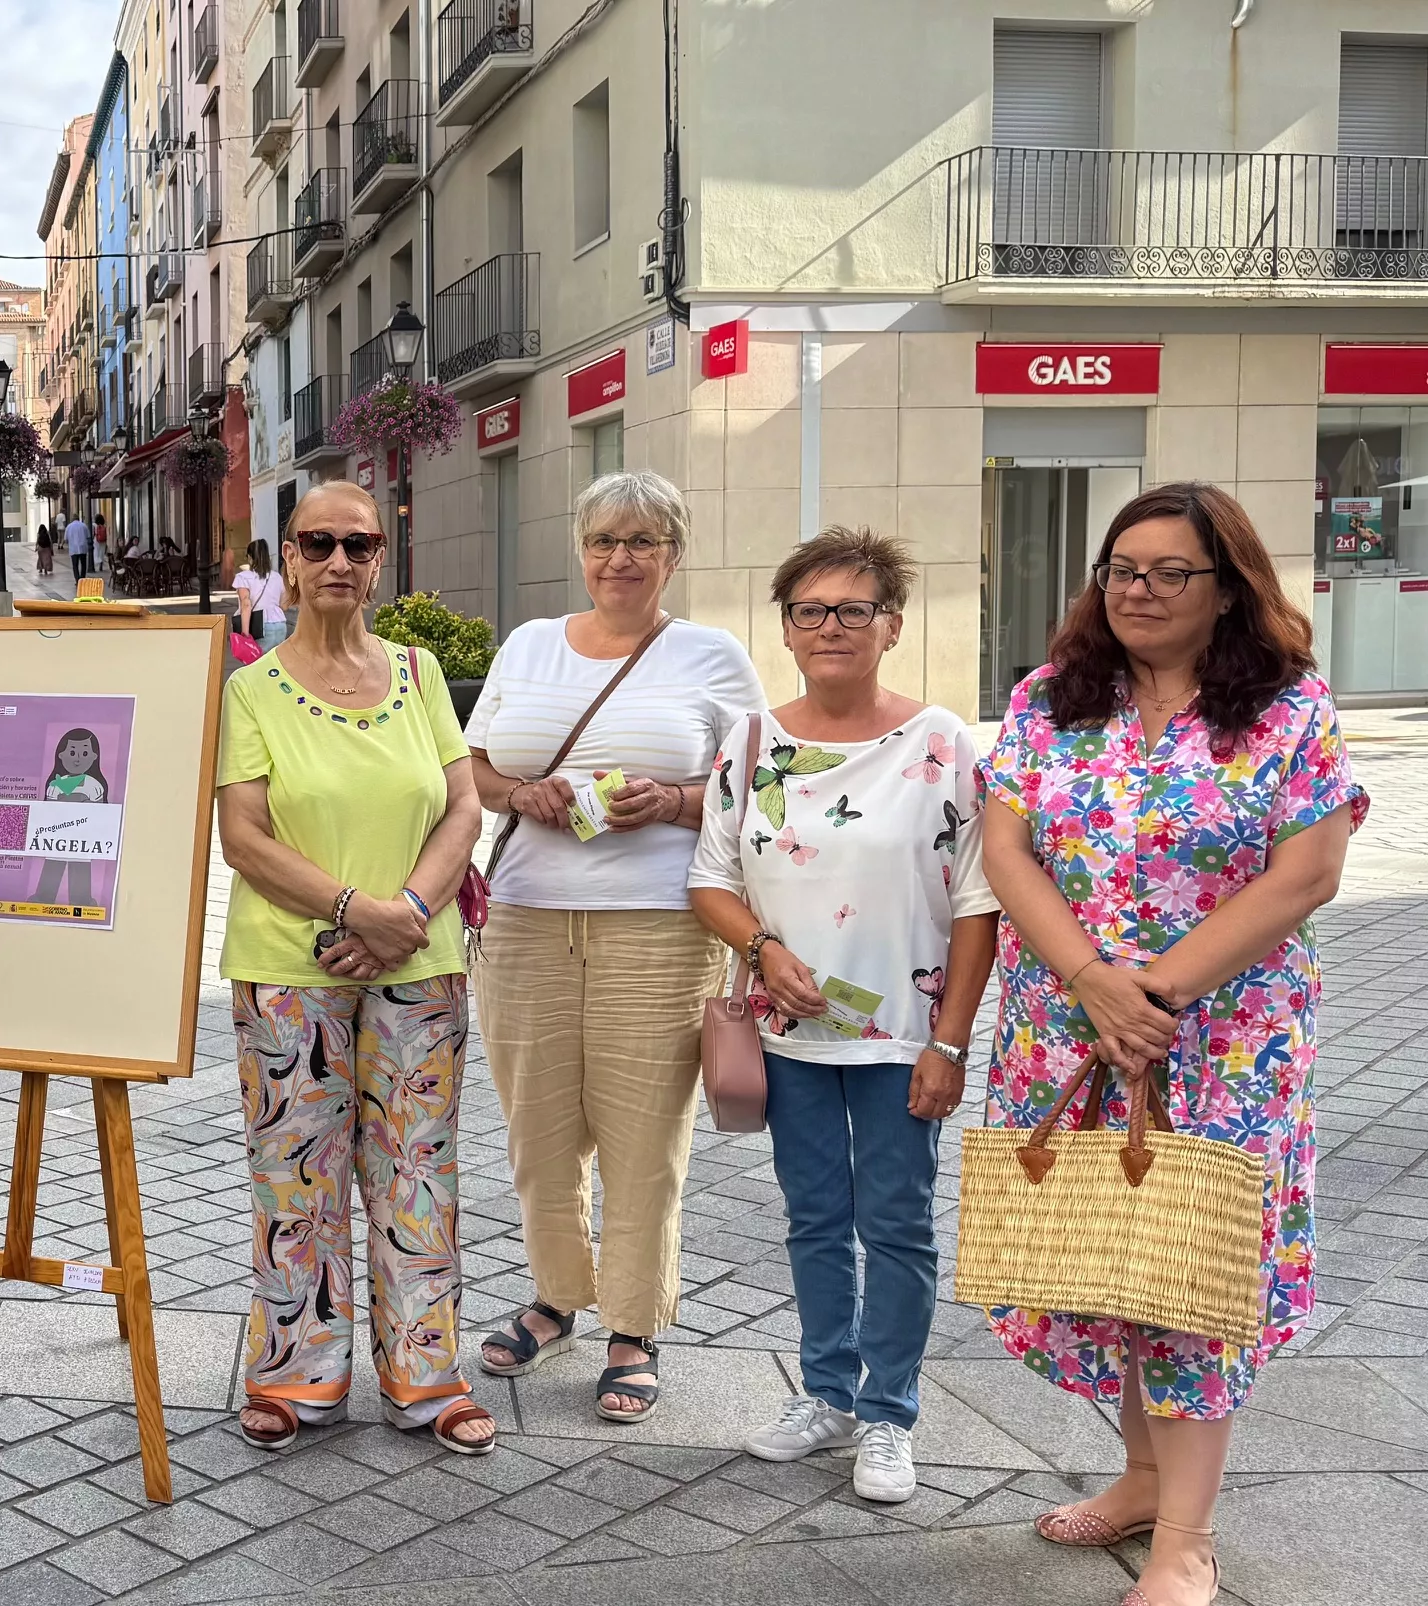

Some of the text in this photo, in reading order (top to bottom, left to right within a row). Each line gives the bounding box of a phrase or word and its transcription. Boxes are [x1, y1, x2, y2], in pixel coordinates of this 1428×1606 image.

[710, 337, 735, 356] GAES
[1028, 355, 1112, 386] GAES
[485, 410, 509, 439] GAES
[1335, 535, 1356, 548] 2x1
[35, 816, 88, 838] ¿Preguntas por
[29, 836, 113, 854] ÁNGELA?
